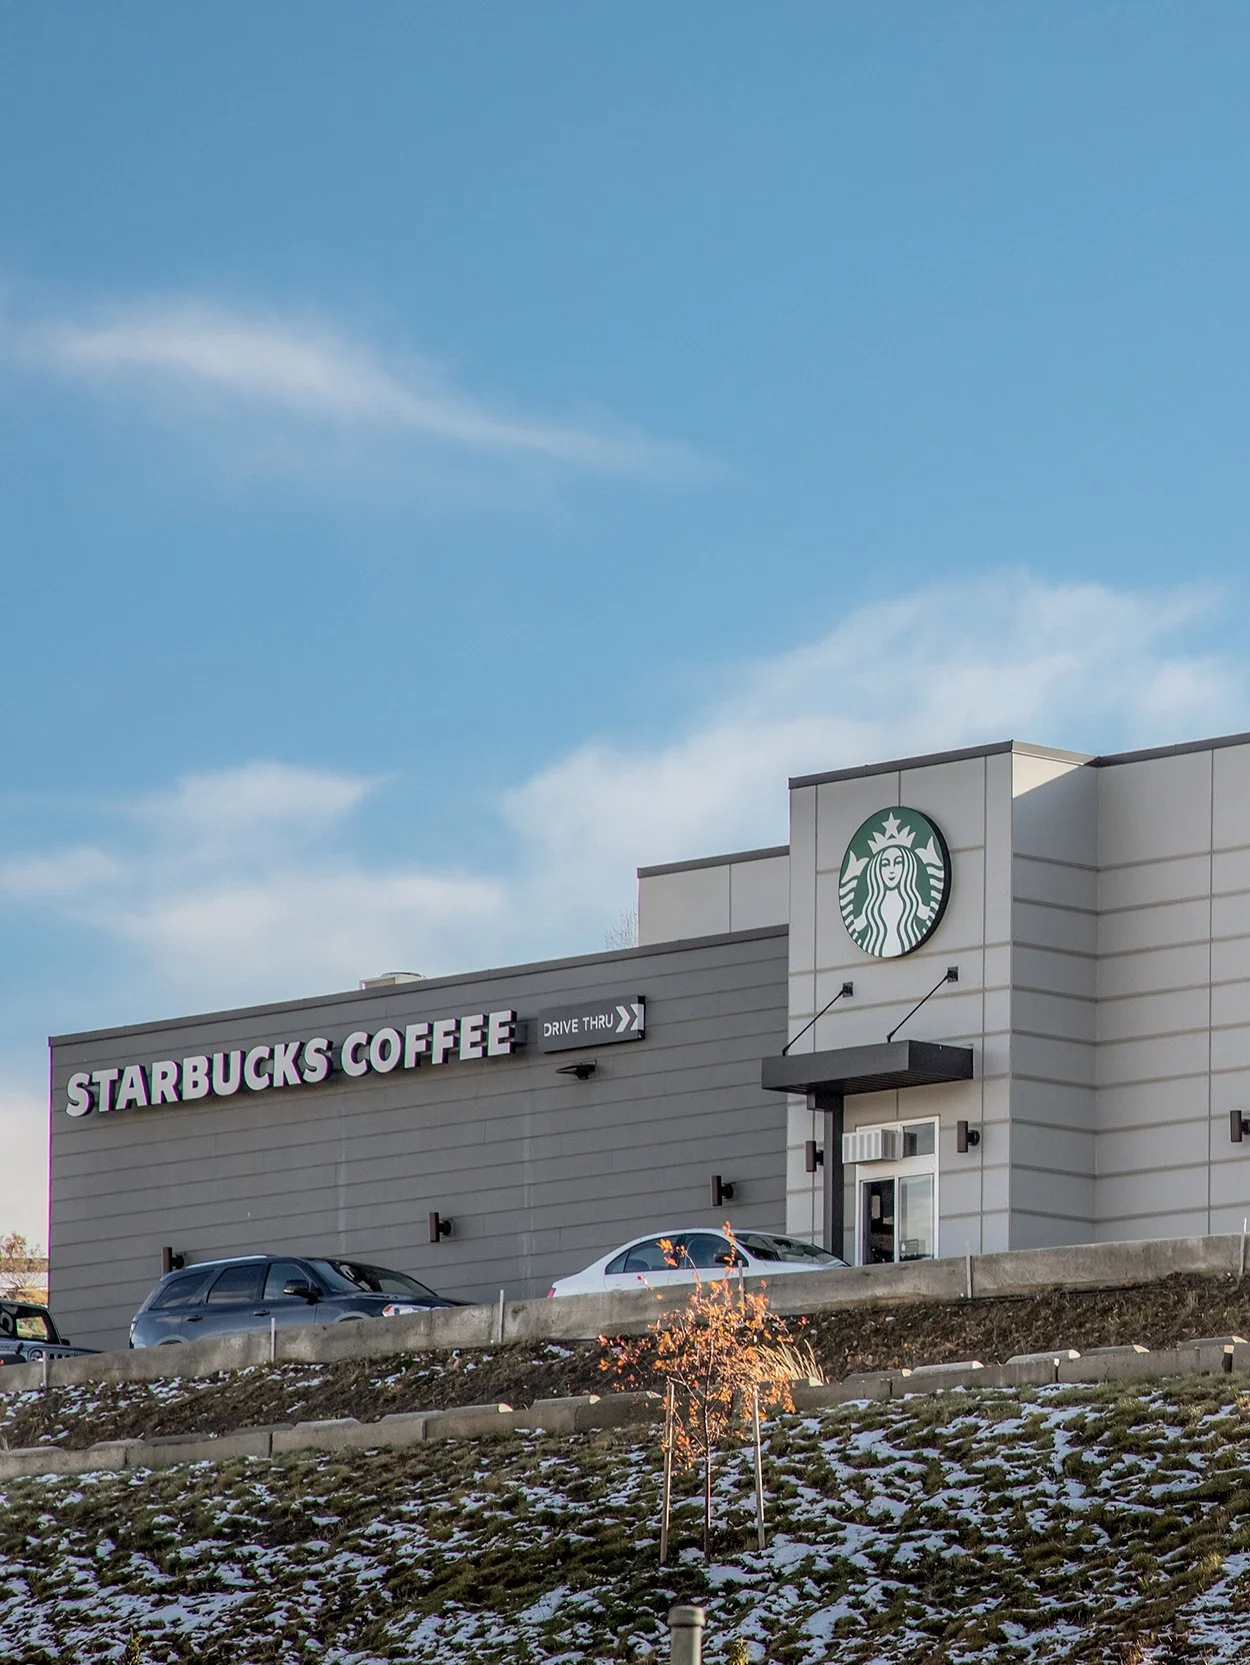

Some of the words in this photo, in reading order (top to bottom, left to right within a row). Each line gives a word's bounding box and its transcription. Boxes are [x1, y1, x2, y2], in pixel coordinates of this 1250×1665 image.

[543, 1018, 579, 1037] DRIVE
[582, 1013, 614, 1032] THRU
[64, 1037, 333, 1118] STARBUCKS
[340, 1009, 516, 1077] COFFEE
